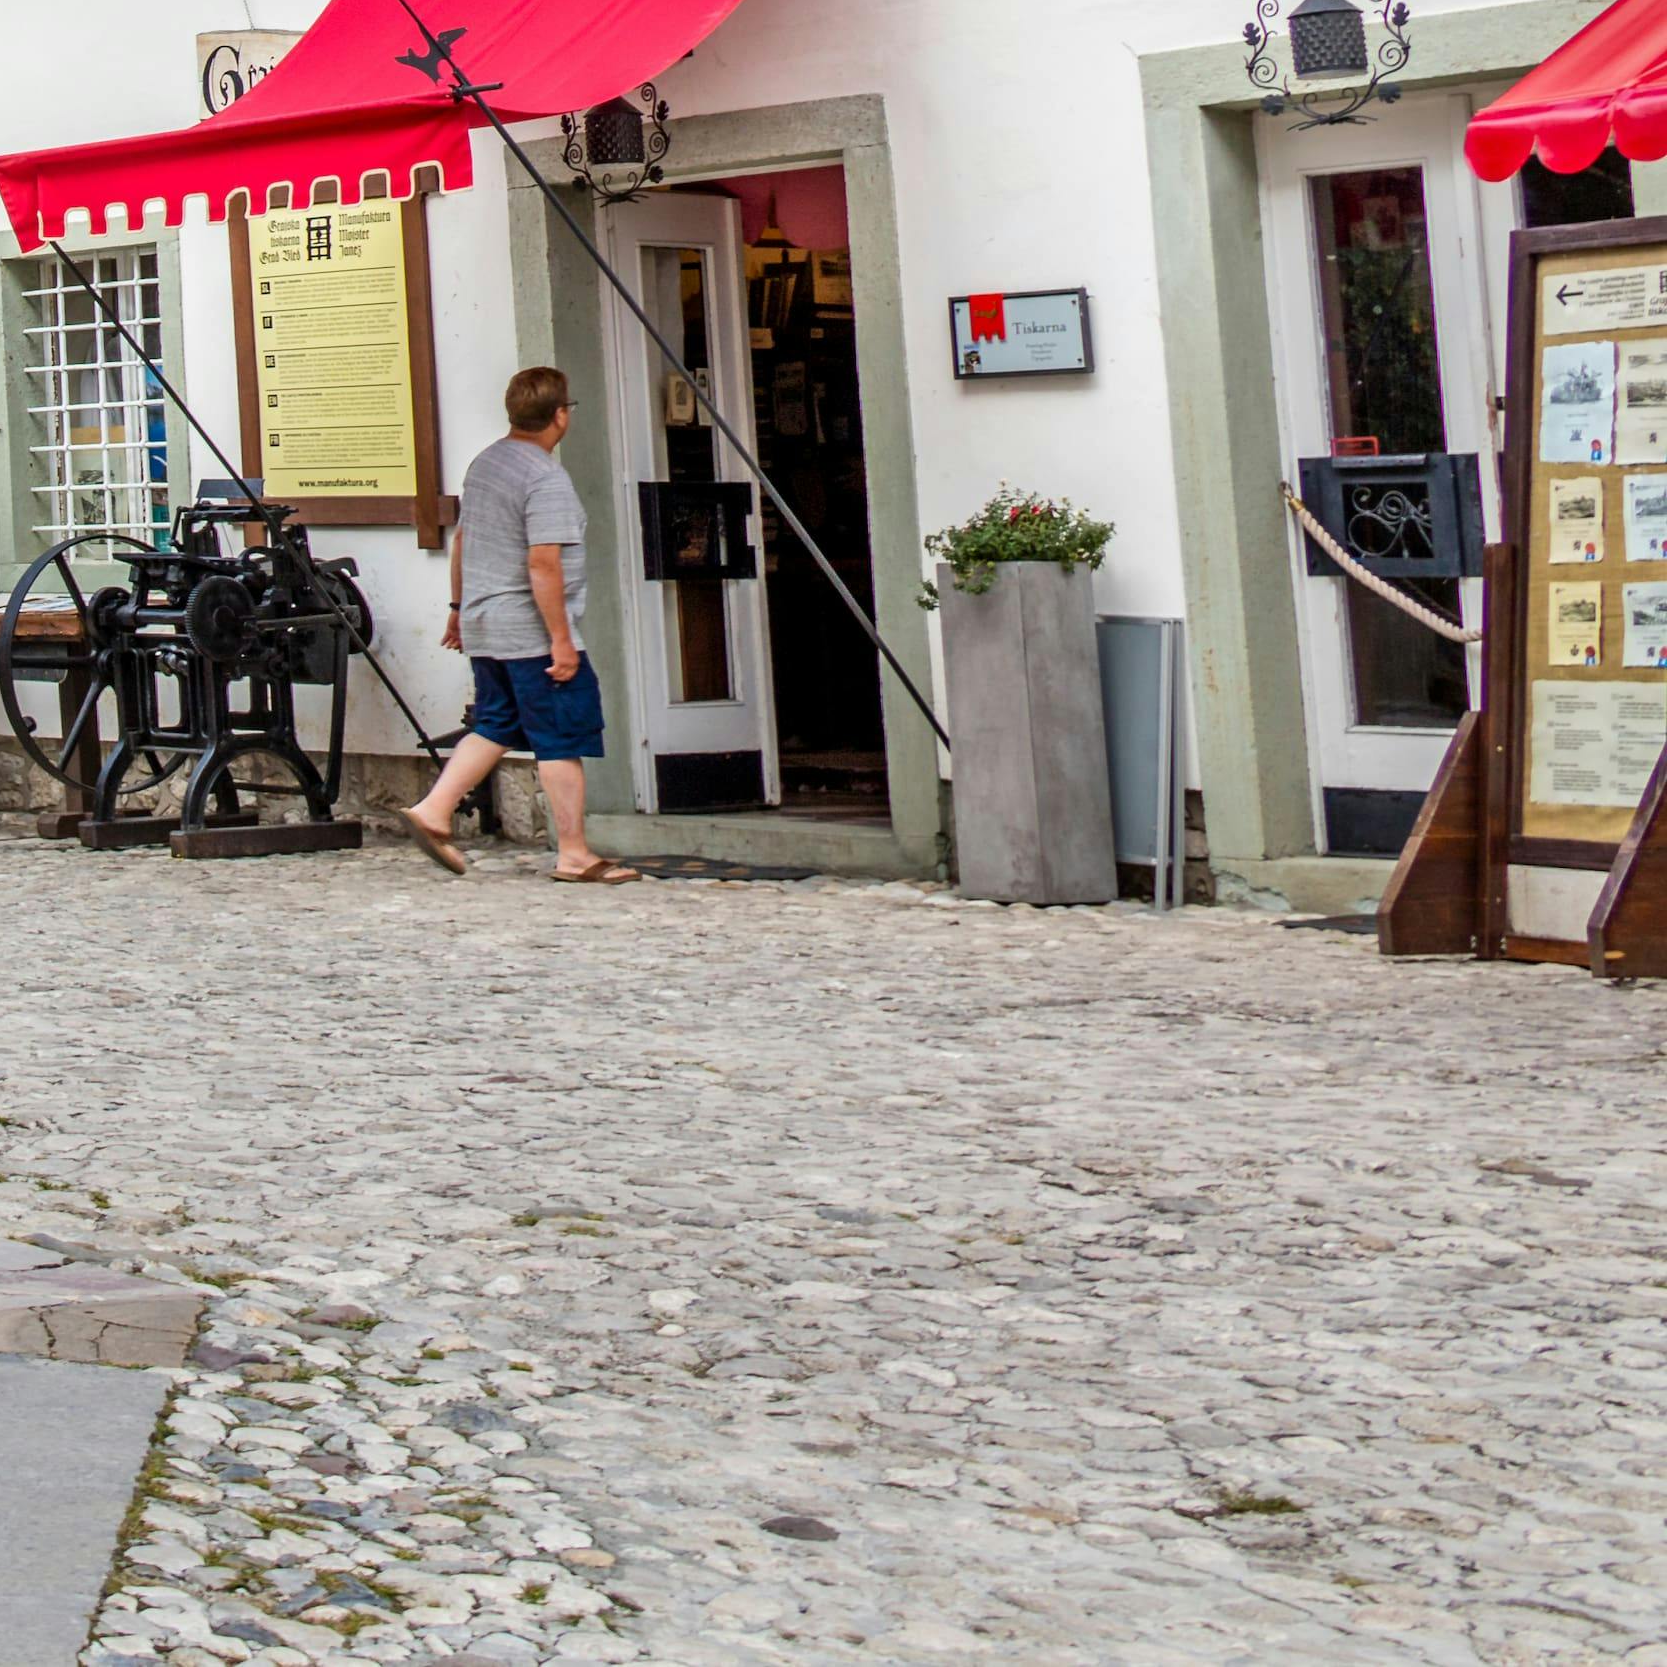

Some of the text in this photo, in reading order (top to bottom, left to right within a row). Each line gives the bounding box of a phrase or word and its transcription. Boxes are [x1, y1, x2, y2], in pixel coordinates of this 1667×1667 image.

[338, 211, 391, 226] Manufaktura
[1012, 320, 1067, 335] Tiskarna
[298, 478, 378, 489] www.manufaktura.org
